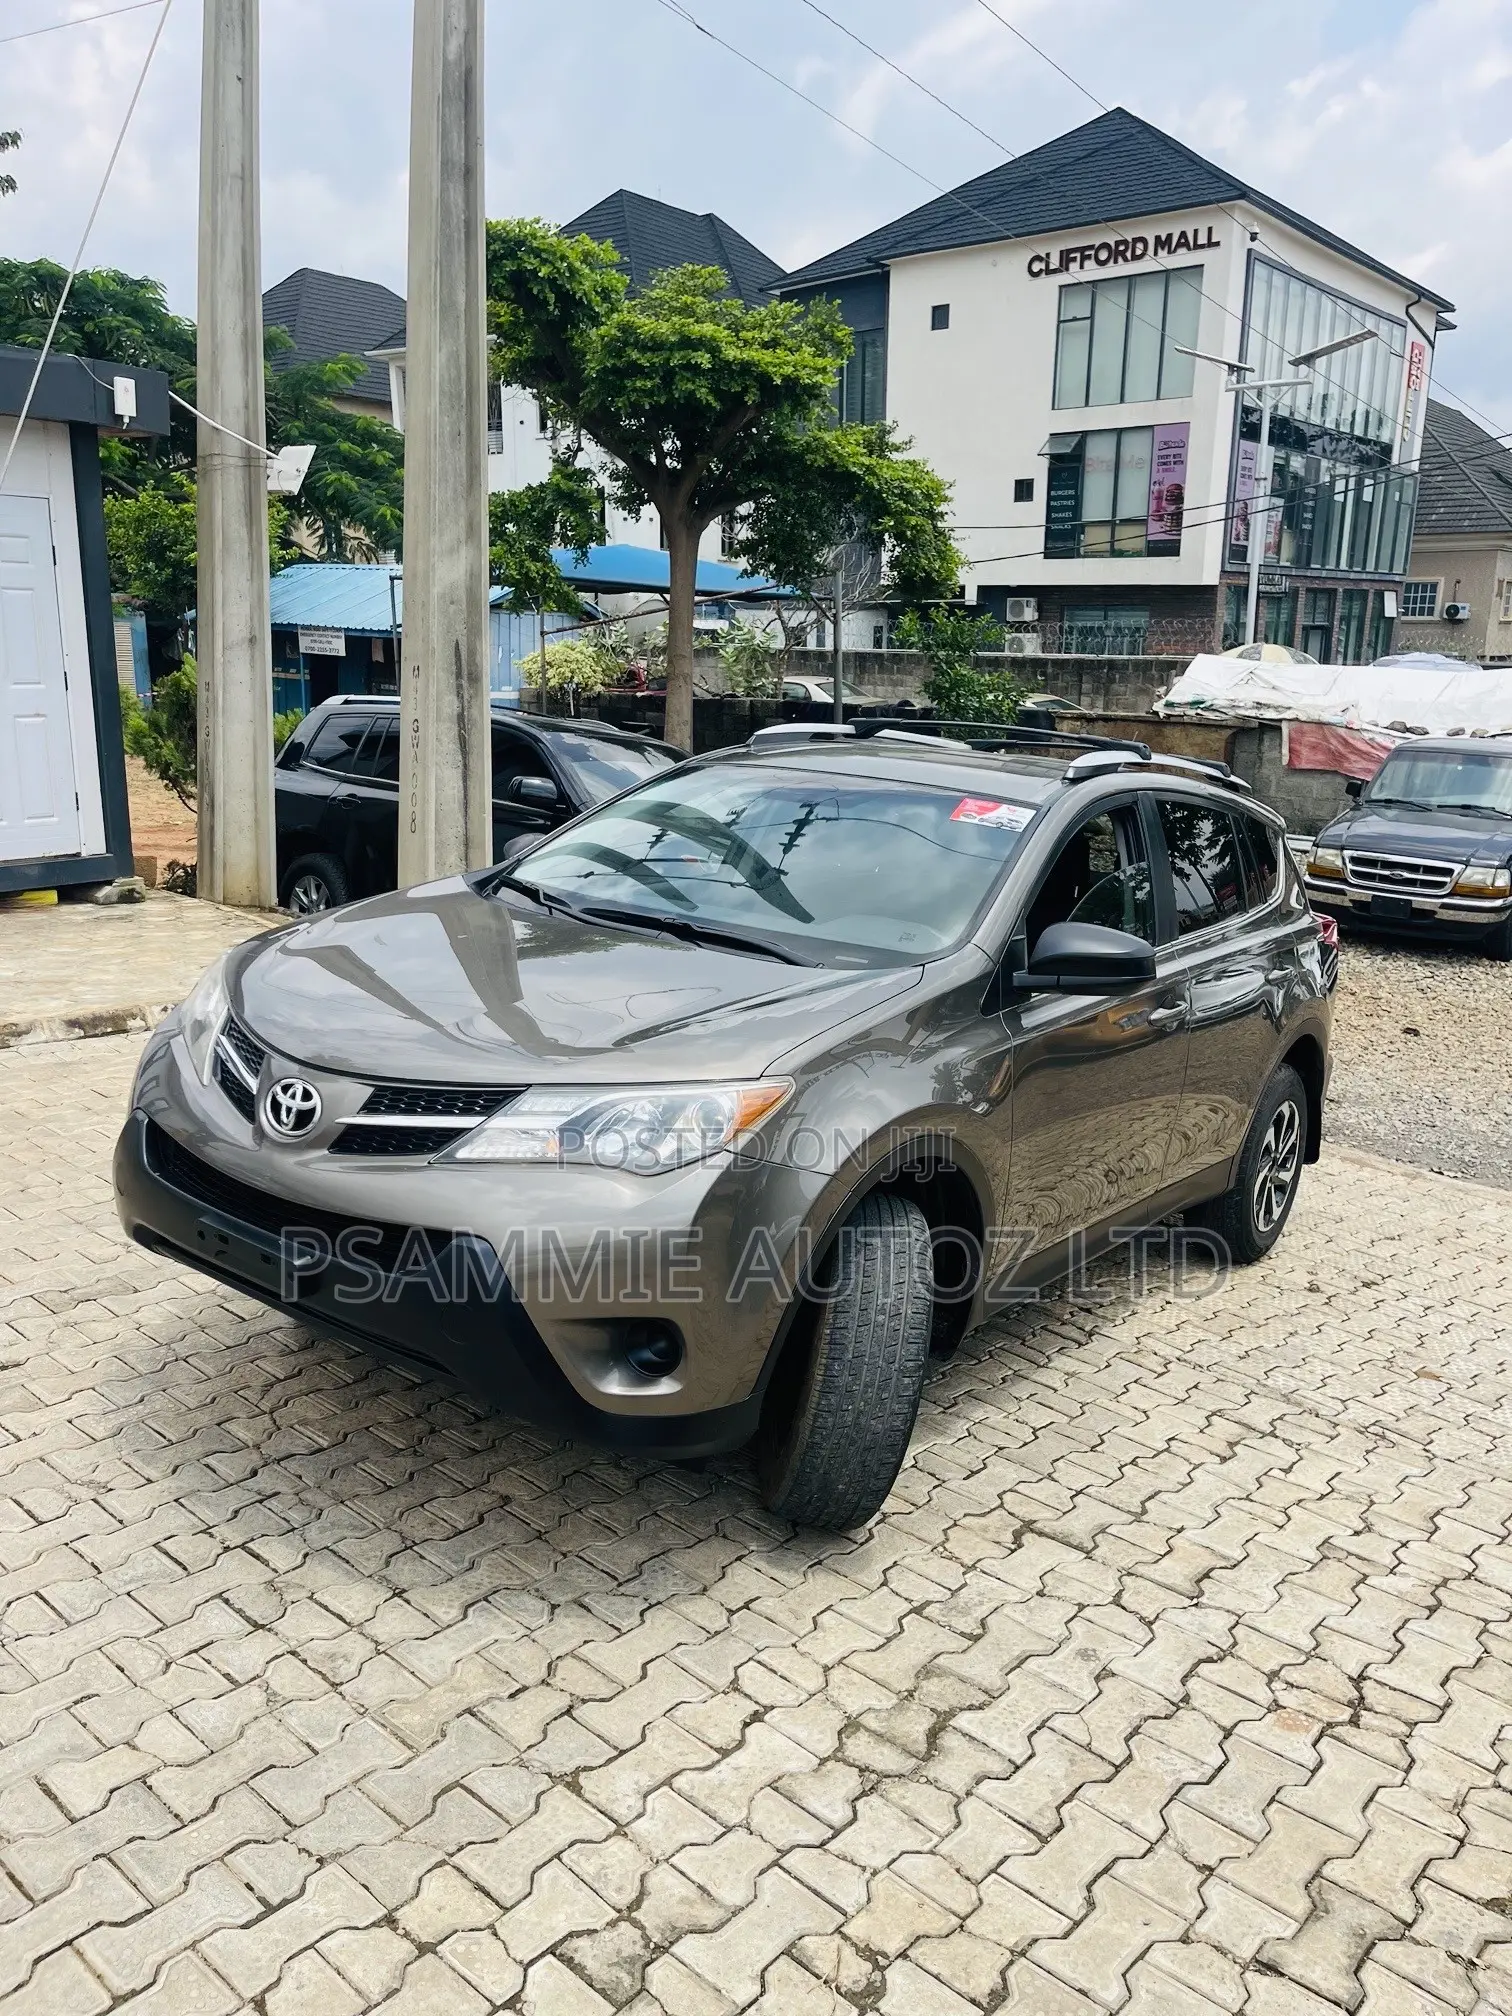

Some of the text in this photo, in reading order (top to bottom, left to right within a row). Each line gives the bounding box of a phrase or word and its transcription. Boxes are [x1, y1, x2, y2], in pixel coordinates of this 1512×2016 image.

[1027, 226, 1221, 278] CLIFFORD MALL
[1050, 499, 1075, 507] PASTRIES
